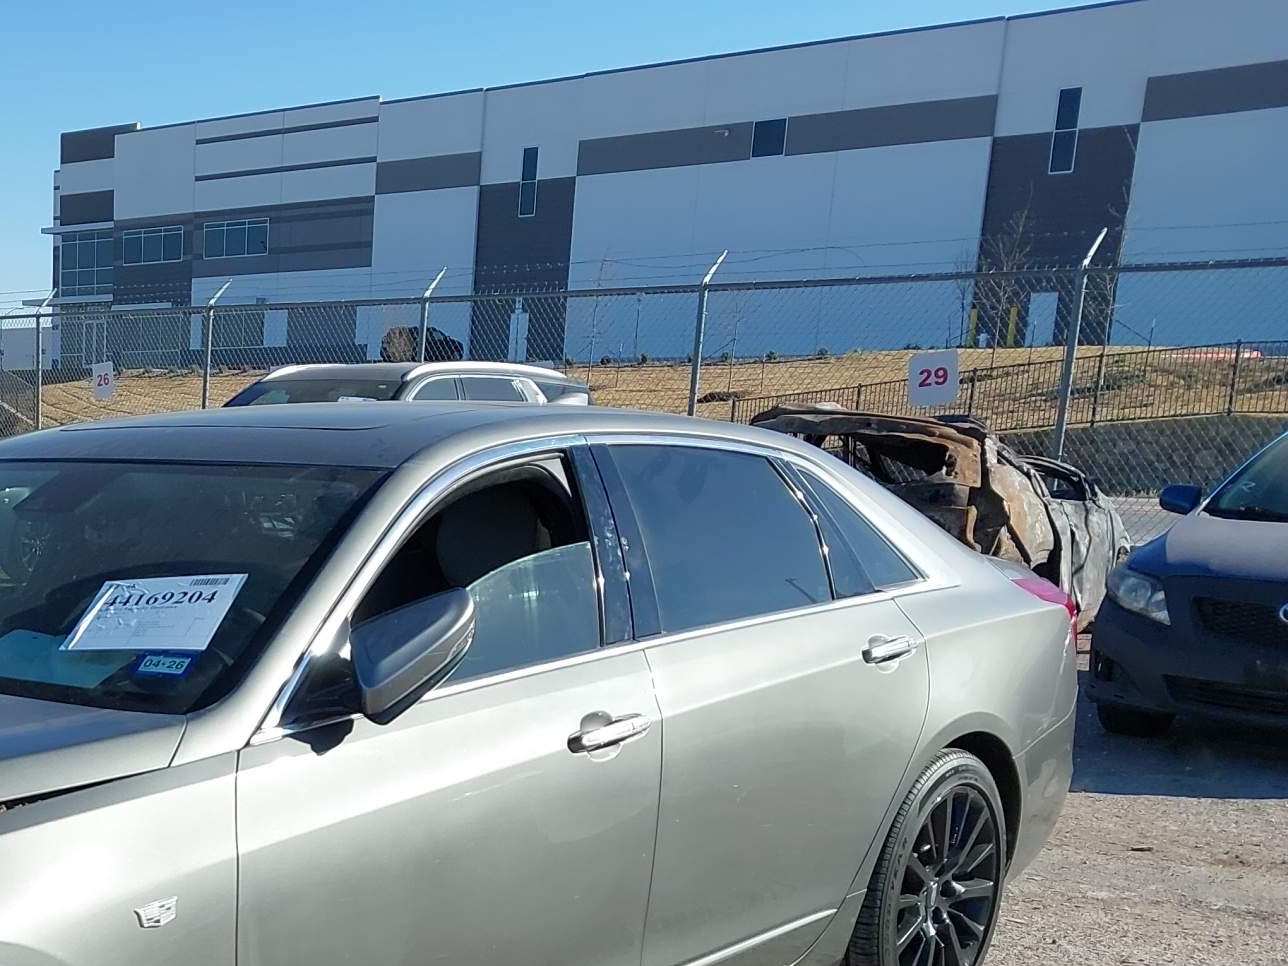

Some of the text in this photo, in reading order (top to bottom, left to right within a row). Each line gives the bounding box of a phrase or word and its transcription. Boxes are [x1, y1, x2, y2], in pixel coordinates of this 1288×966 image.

[96, 373, 110, 387] 26
[918, 366, 949, 388] 29
[104, 589, 219, 607] 44169204
